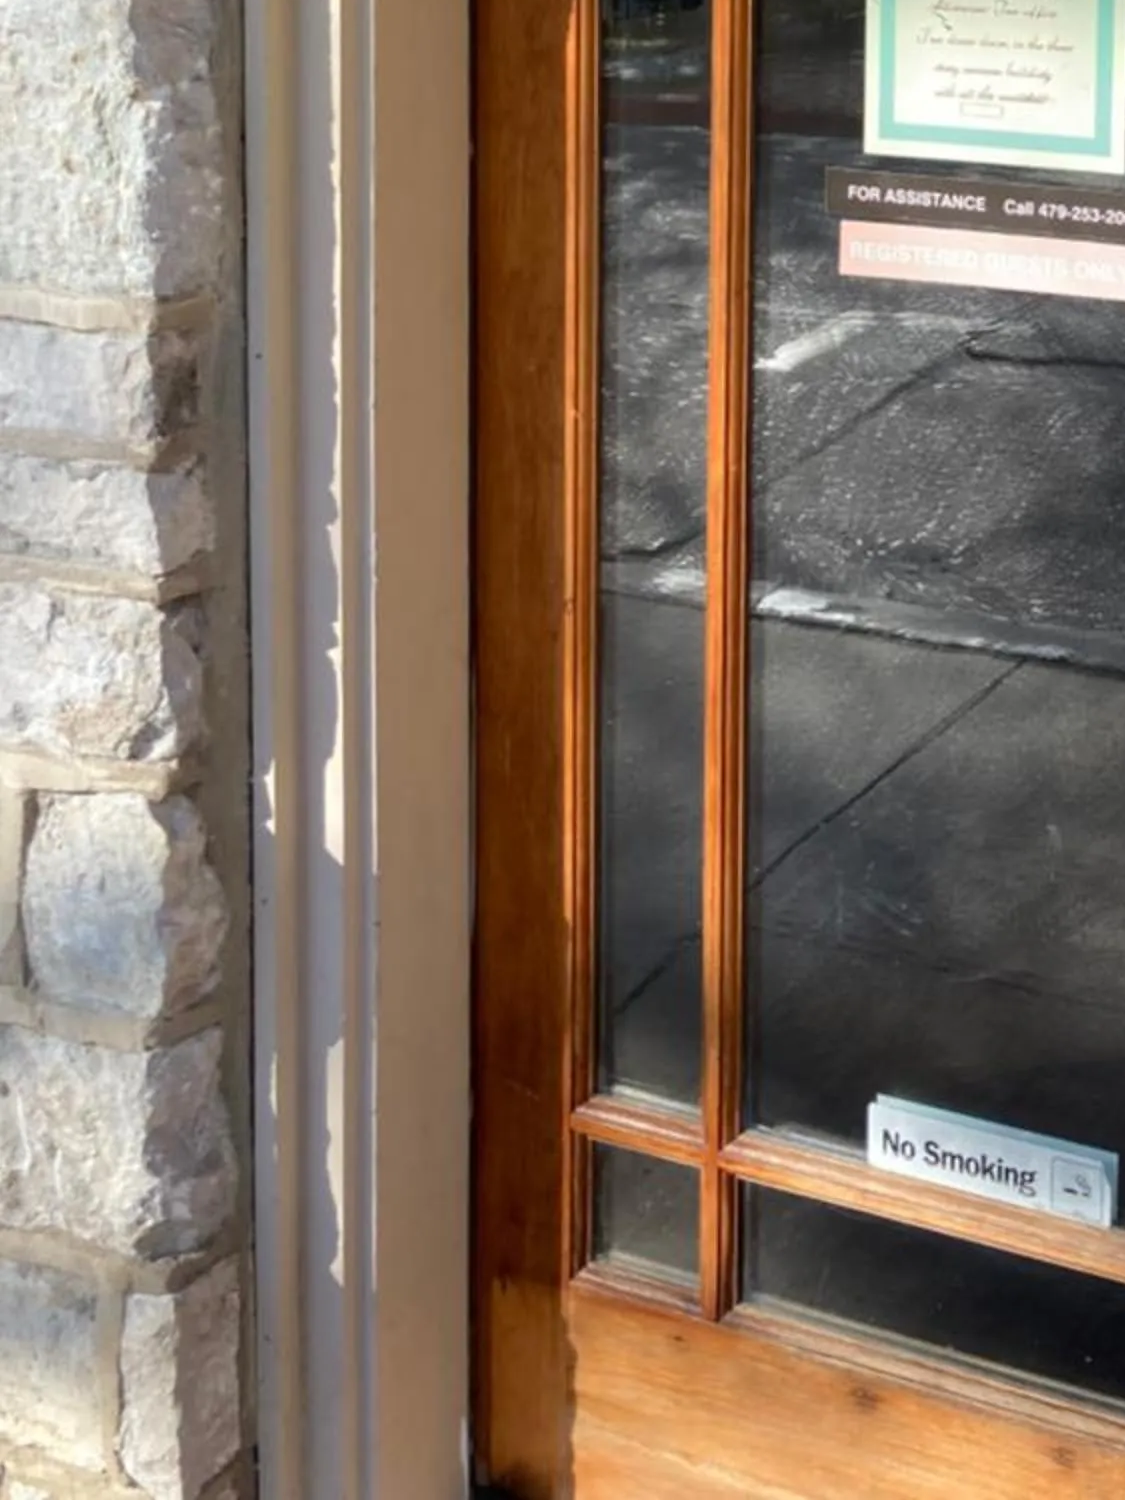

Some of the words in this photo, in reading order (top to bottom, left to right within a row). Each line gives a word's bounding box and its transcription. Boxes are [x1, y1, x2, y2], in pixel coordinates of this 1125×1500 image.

[847, 185, 881, 202] FOR
[884, 187, 986, 212] ASSISTANCE
[1003, 199, 1034, 216] Call
[881, 1128, 916, 1160] No
[923, 1139, 1038, 1198] Smoking
